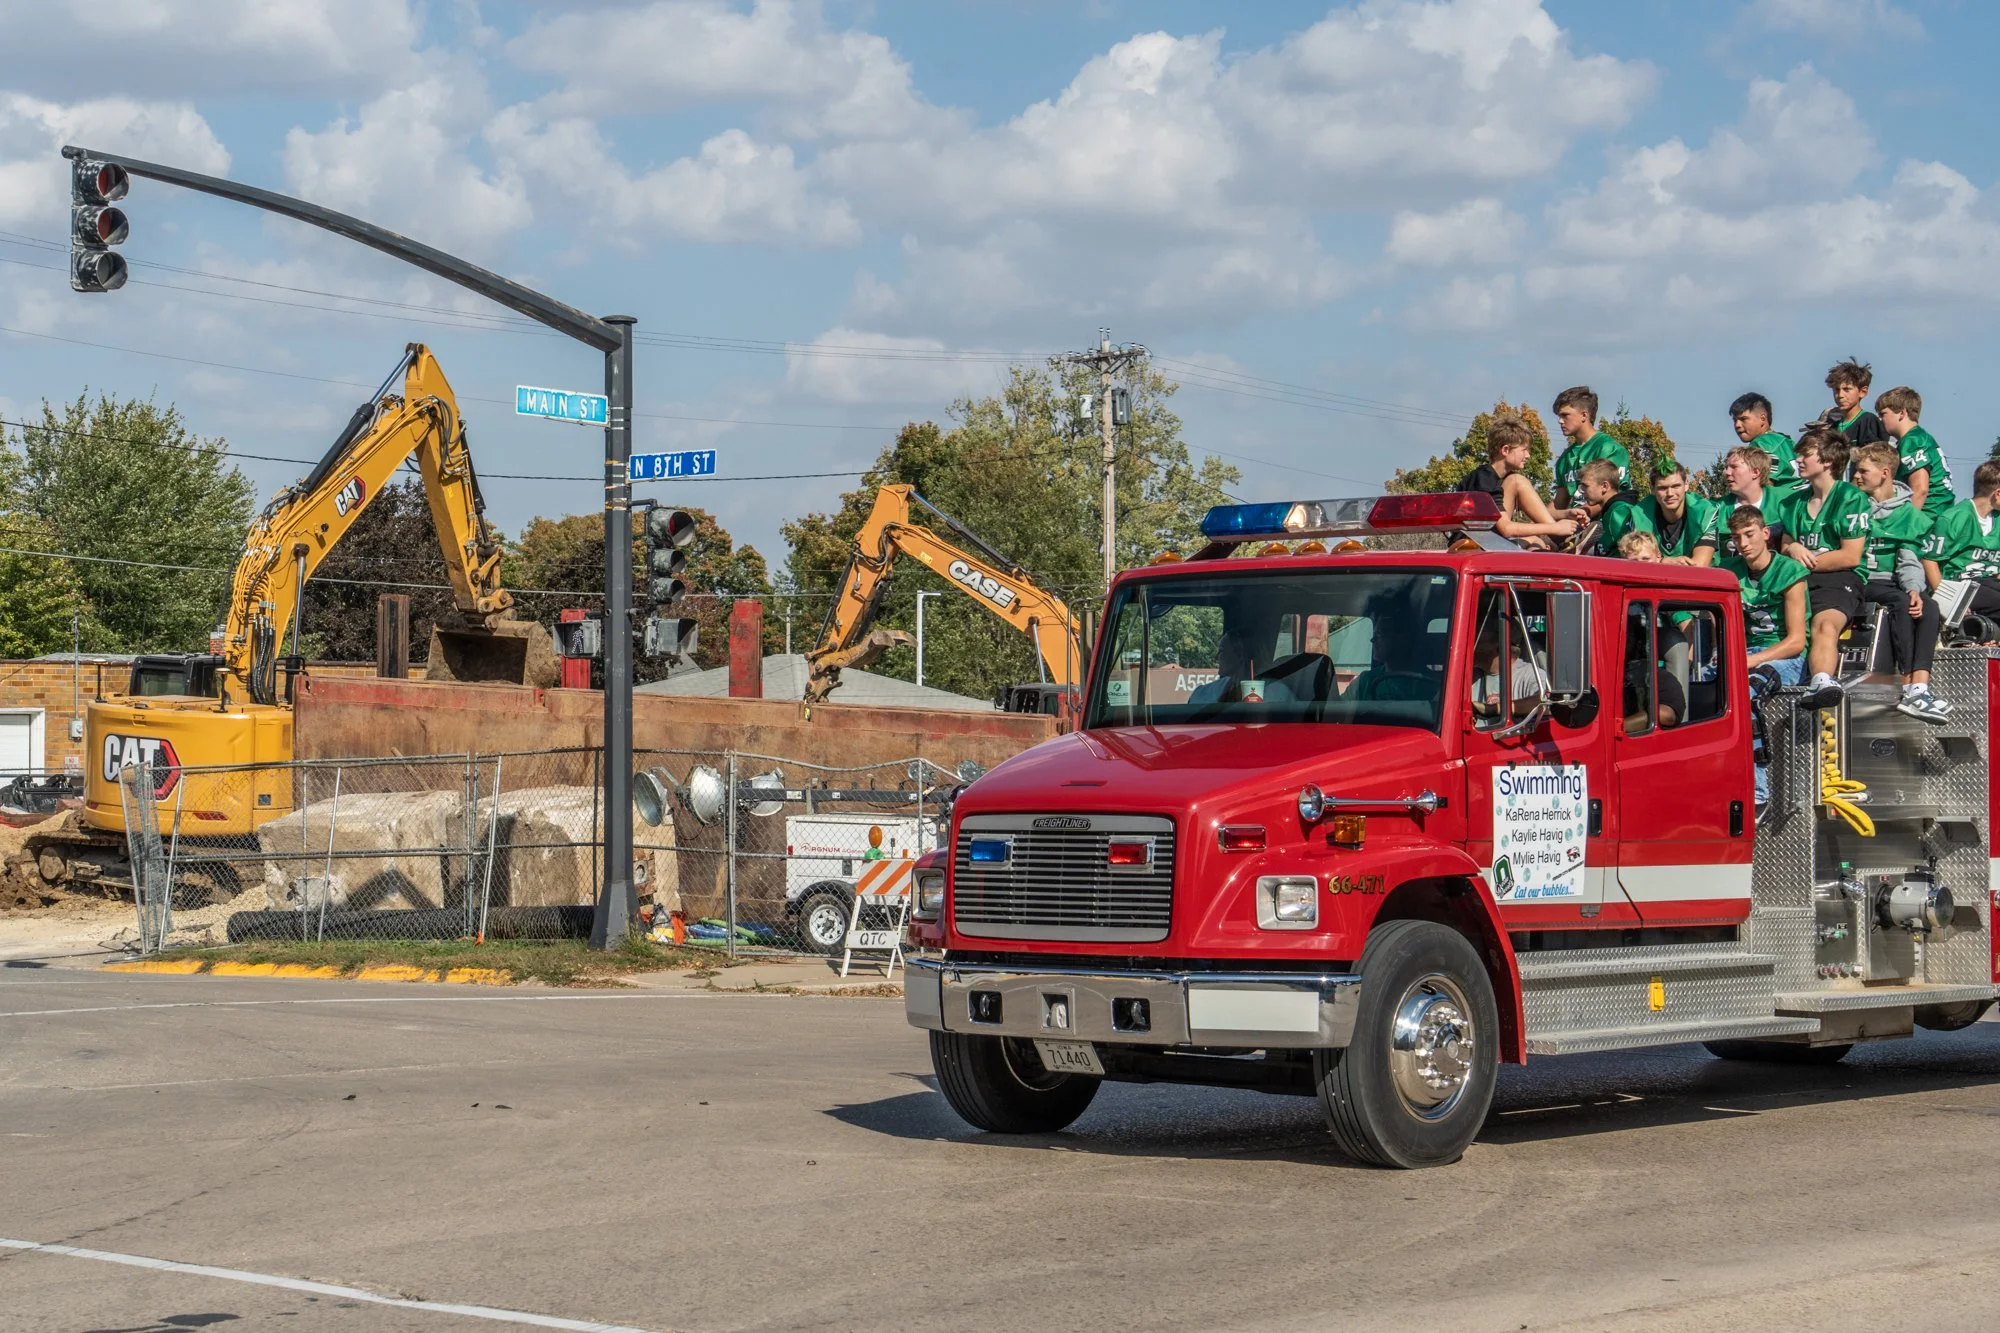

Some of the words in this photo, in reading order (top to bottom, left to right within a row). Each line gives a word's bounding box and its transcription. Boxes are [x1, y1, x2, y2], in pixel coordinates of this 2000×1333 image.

[526, 391, 568, 417] MAIN
[579, 399, 598, 419] ST
[635, 458, 644, 477] N
[654, 455, 682, 478] 8TH
[692, 453, 710, 474] ST
[1901, 449, 1928, 470] 54
[335, 479, 360, 516] CAT
[1846, 512, 1869, 532] 70
[948, 559, 1018, 609] CASE
[104, 734, 160, 782] CAT
[1500, 769, 1581, 800] Swimming
[1034, 818, 1088, 828] FREIGHTLINER
[1505, 808, 1540, 821] KaRena
[1542, 807, 1572, 821] Herrick
[1512, 828, 1537, 845] Kaylie
[1540, 828, 1563, 843] Havig
[1513, 851, 1535, 867] Mylie
[1537, 850, 1561, 865] Havig
[1328, 875, 1385, 894] 66-471
[1514, 885, 1527, 898] Eat
[1528, 888, 1541, 898] our
[859, 932, 888, 947] QTC
[1047, 1049, 1091, 1067] 71440
